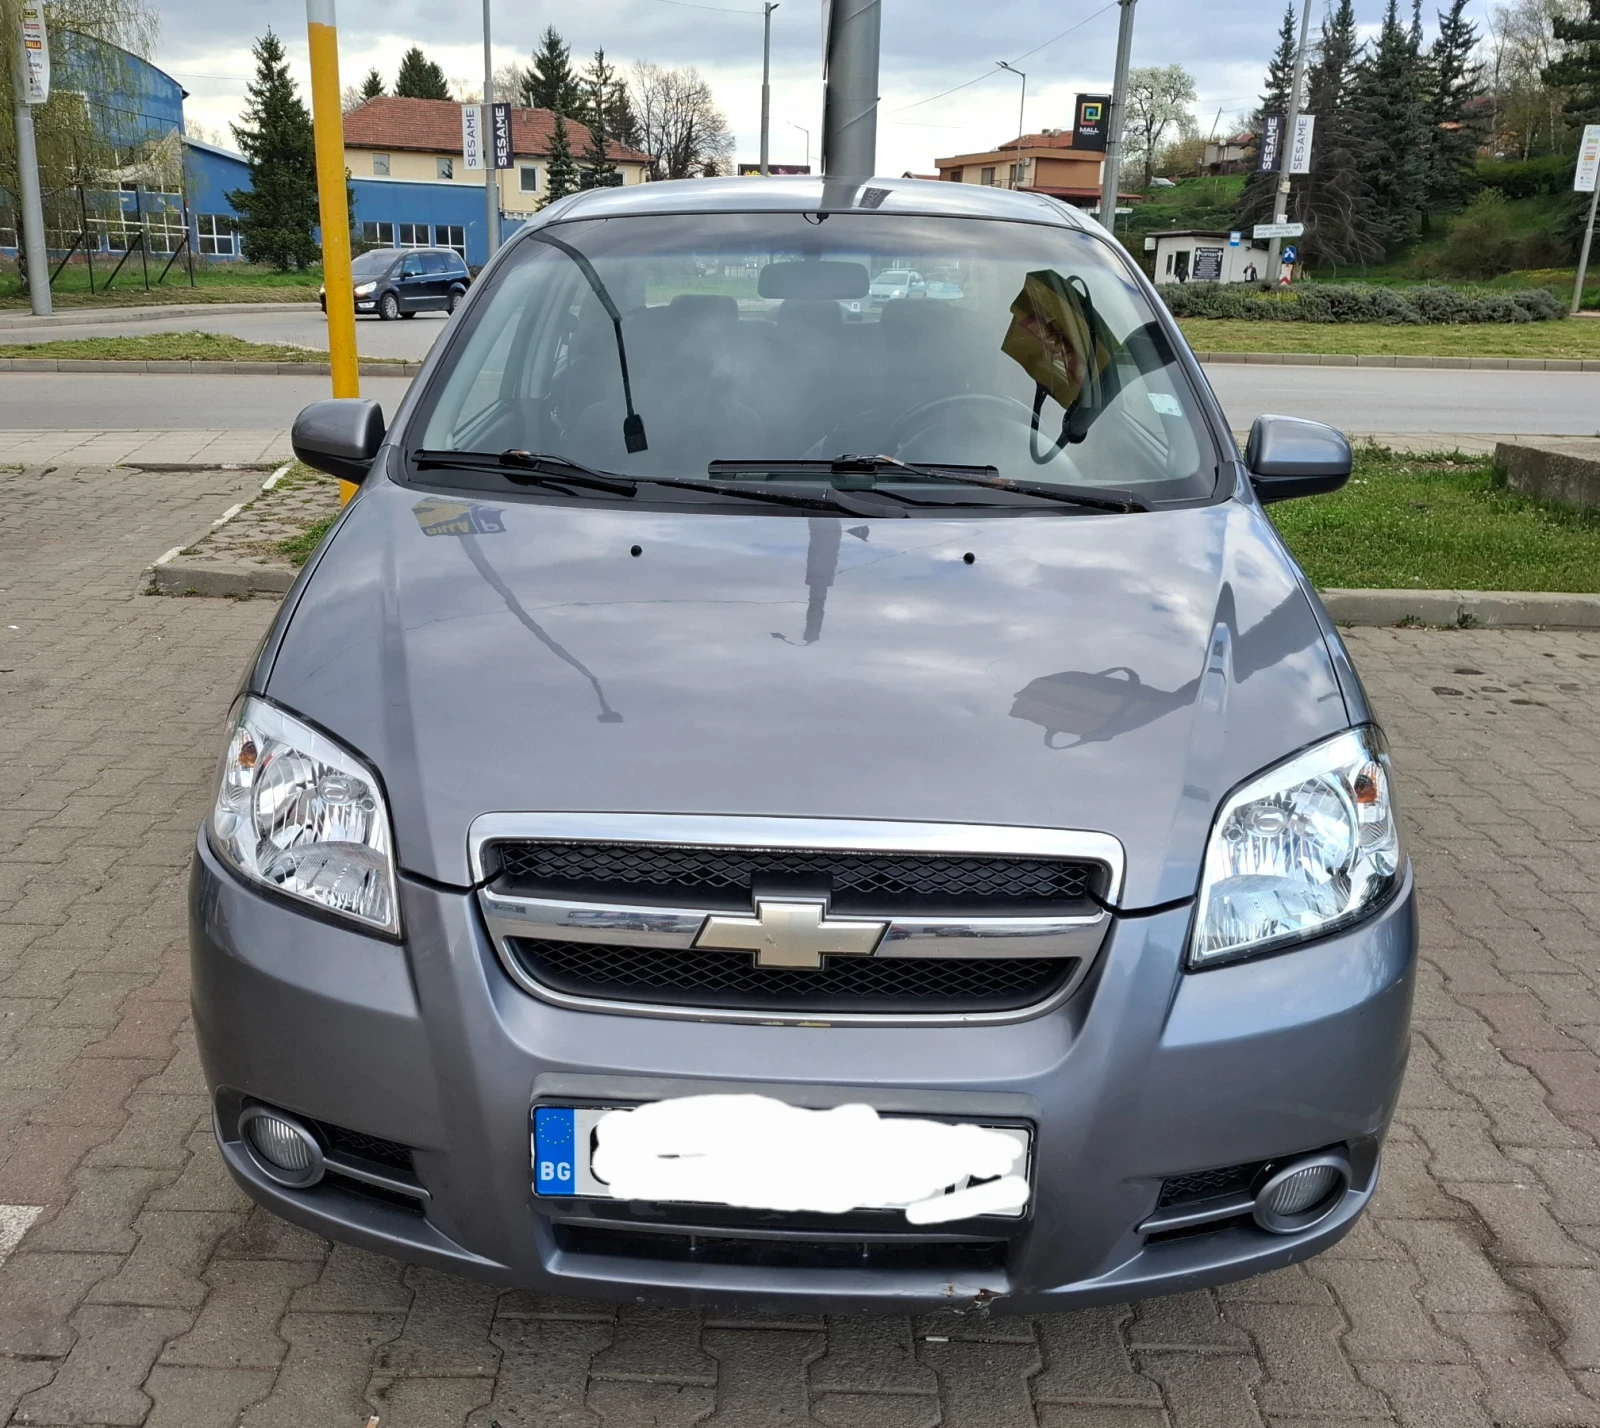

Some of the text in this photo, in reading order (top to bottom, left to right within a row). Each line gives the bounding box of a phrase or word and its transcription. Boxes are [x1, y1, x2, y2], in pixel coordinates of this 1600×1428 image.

[465, 108, 476, 167] SESAME
[495, 105, 507, 166] SESAME
[1262, 116, 1277, 170] SESAME
[1293, 119, 1307, 170] SESAME
[541, 1161, 571, 1181] BG
